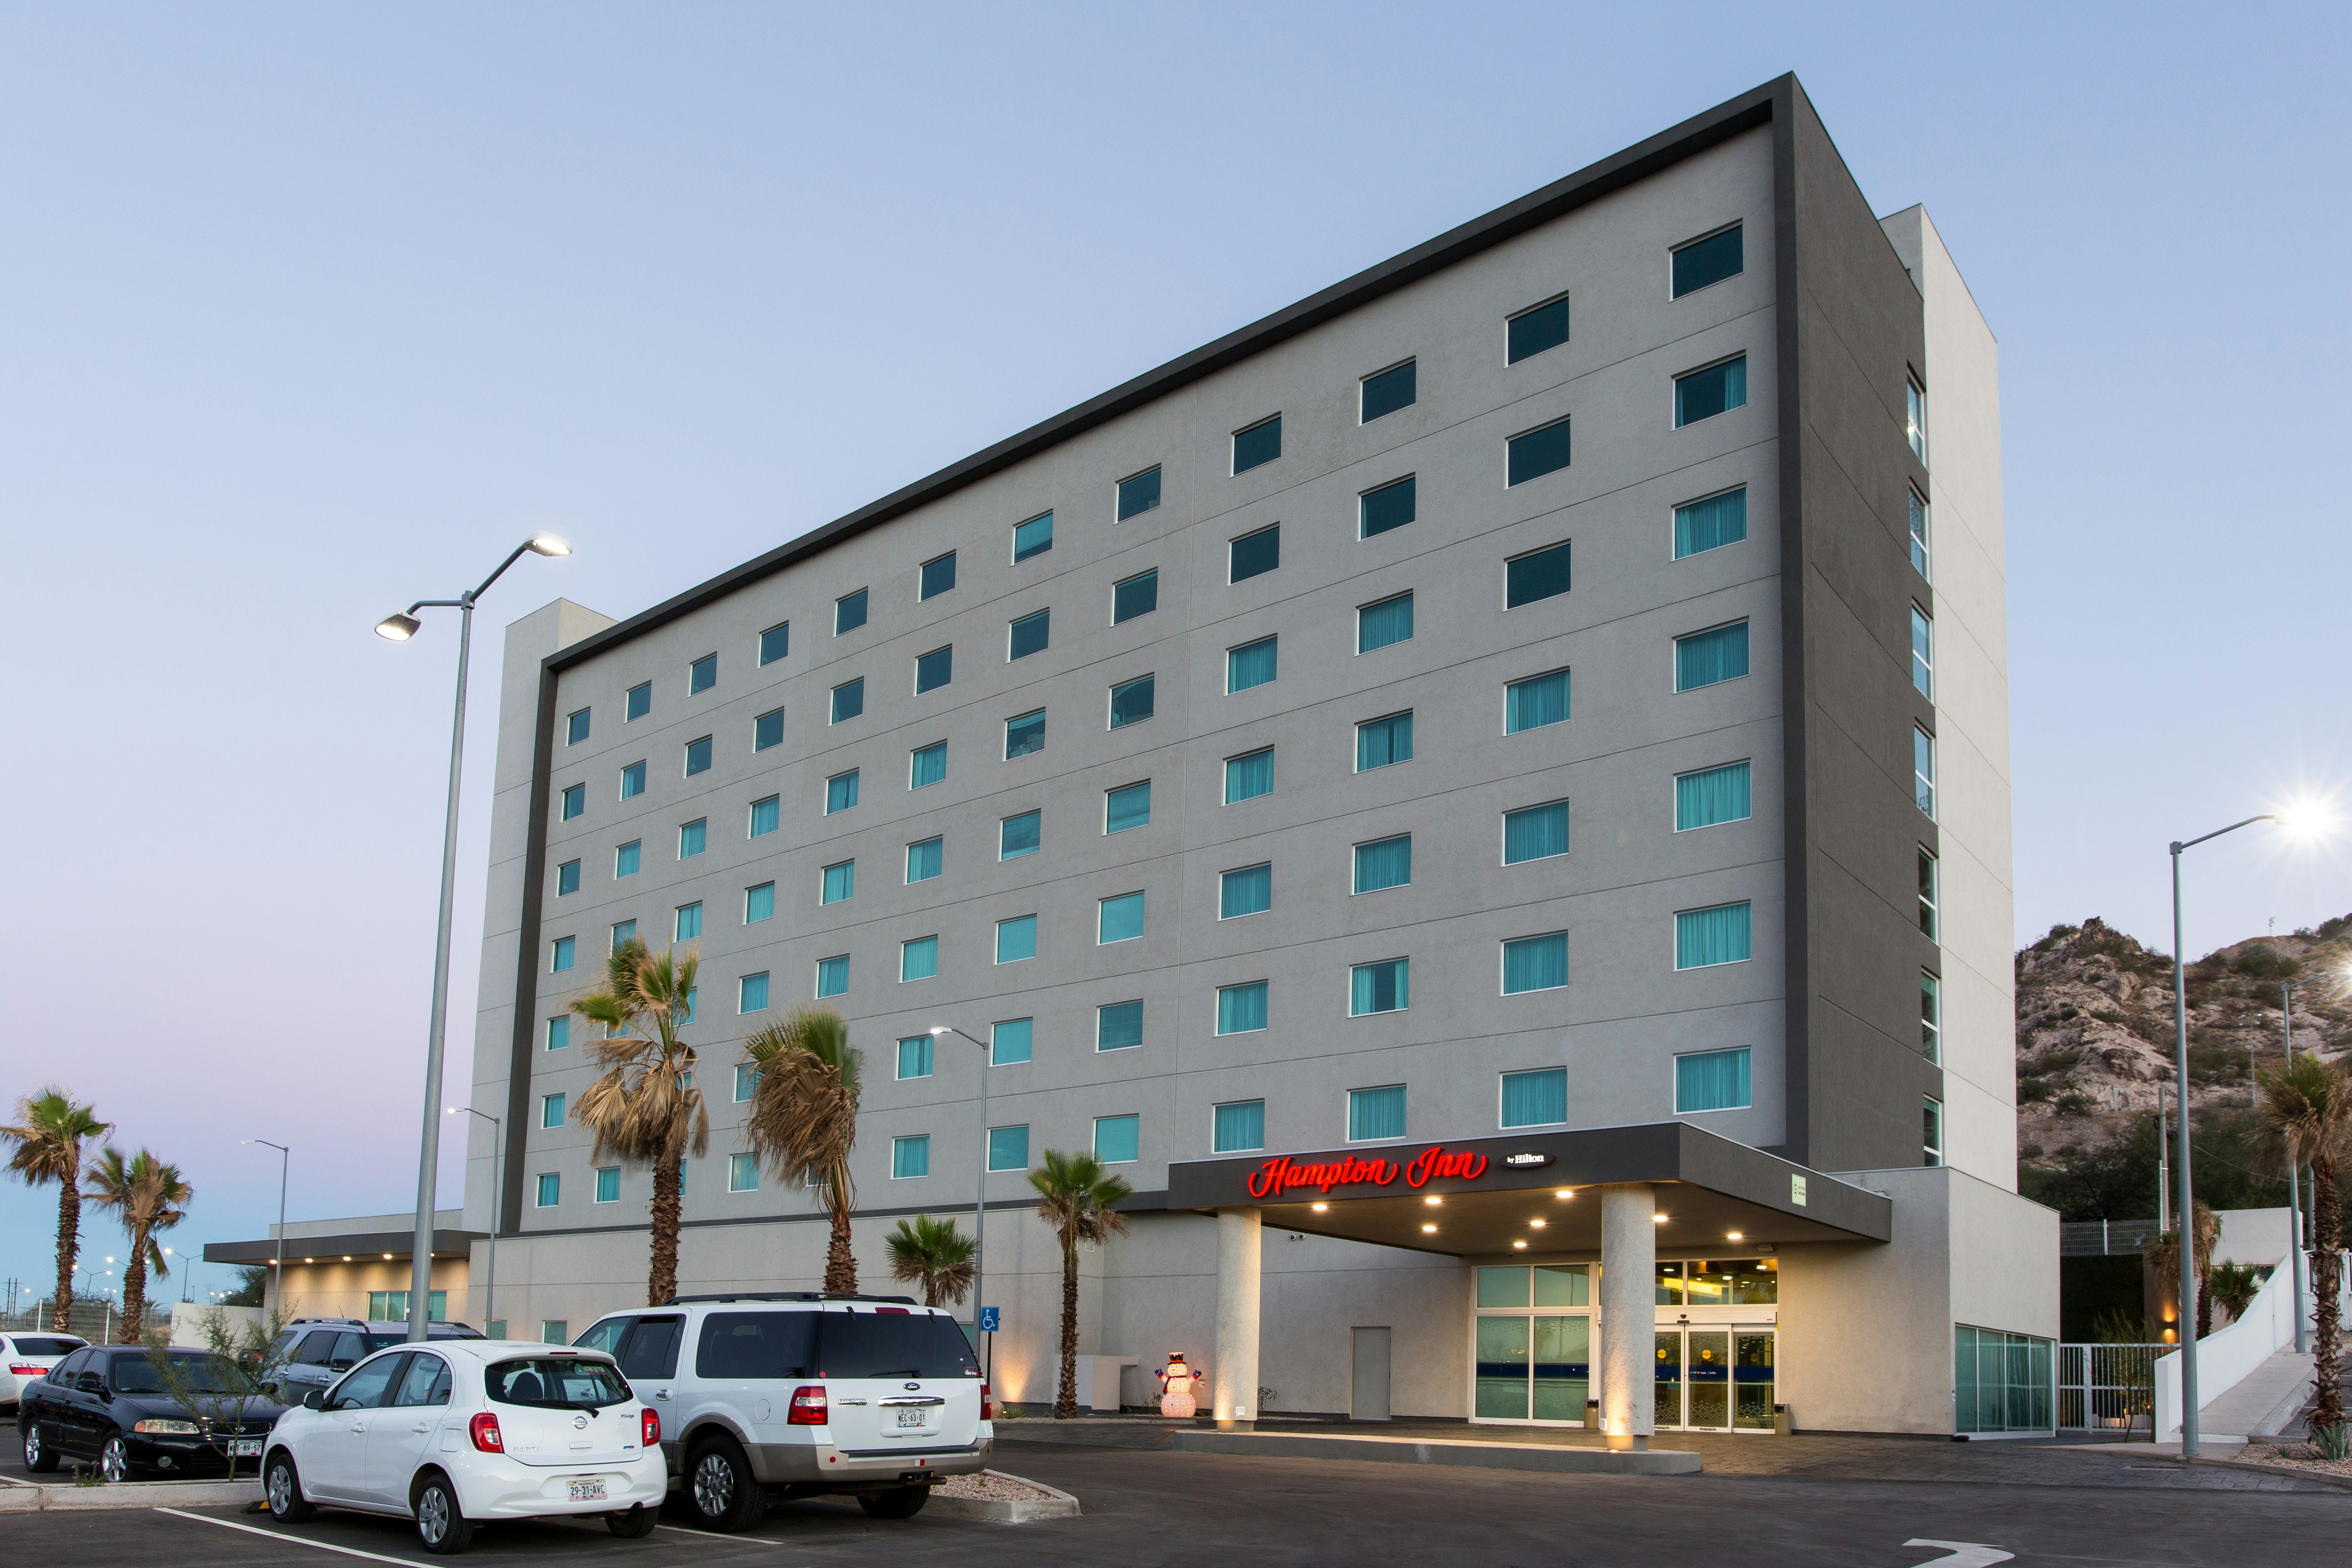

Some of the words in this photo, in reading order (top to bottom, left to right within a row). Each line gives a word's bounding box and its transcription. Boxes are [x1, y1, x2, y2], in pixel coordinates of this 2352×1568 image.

[1515, 1154, 1545, 1163] Hilton
[1248, 1155, 1398, 1198] Hampton
[1406, 1146, 1487, 1188] Inn
[898, 1413, 925, 1422] WEC-63-01
[570, 1484, 605, 1496] 29-31-AVC
